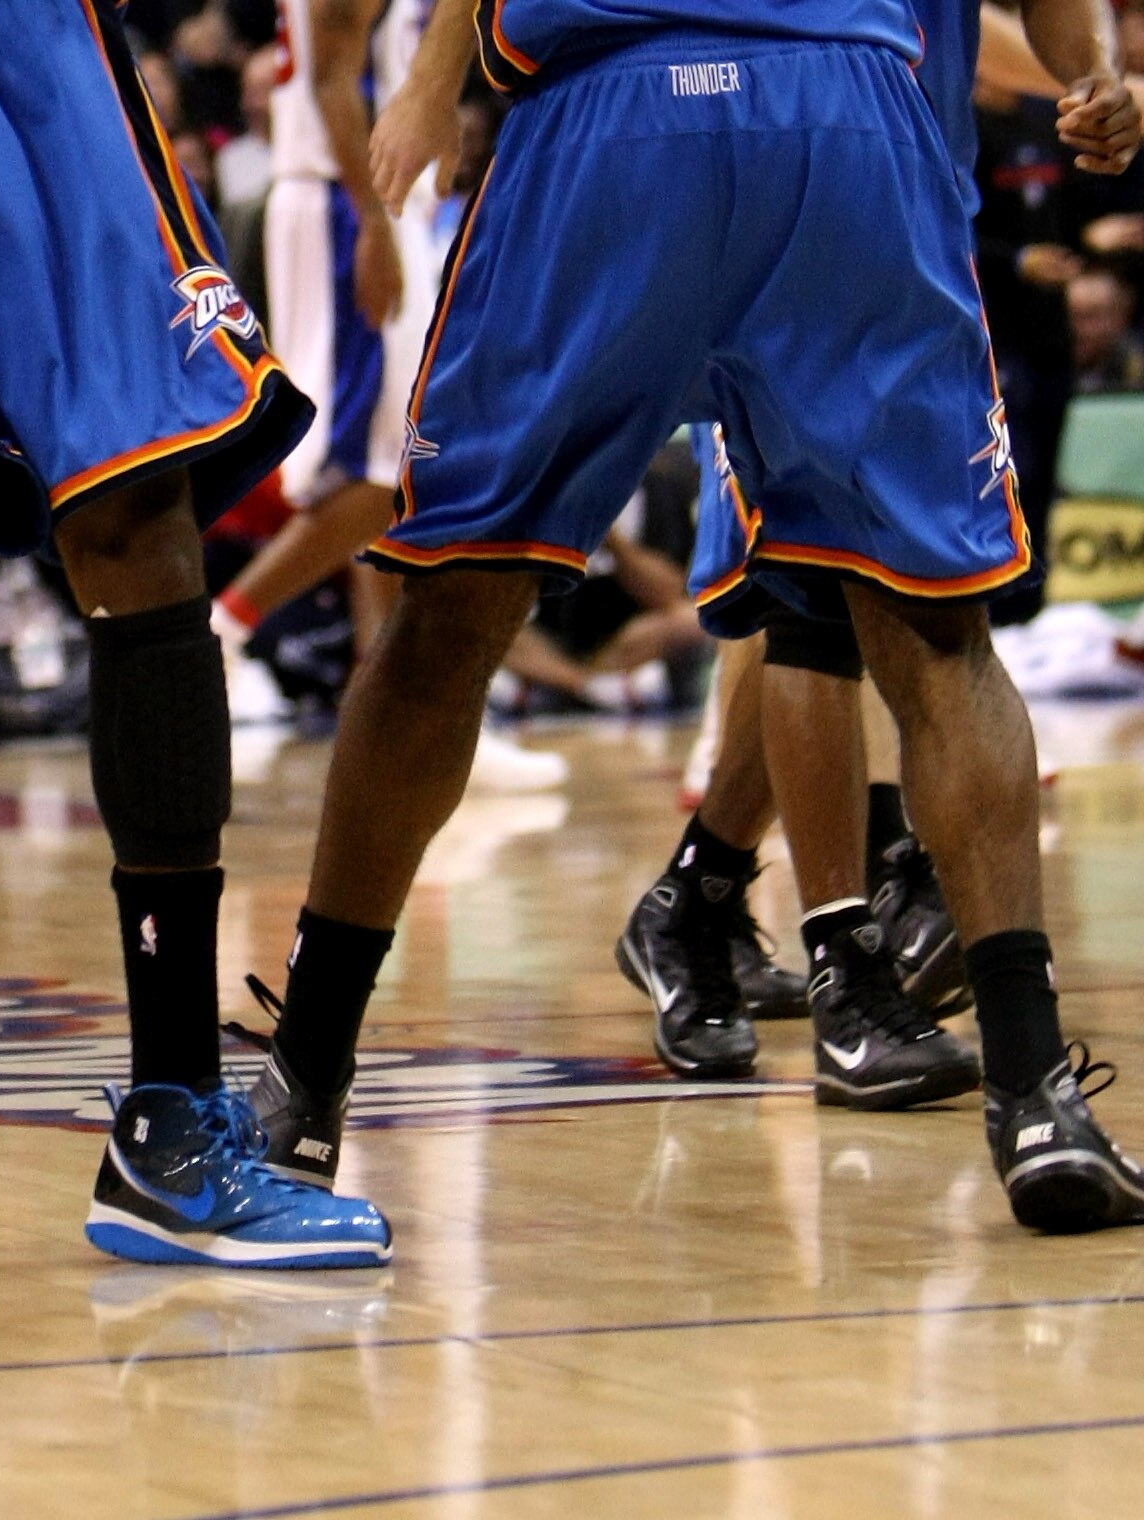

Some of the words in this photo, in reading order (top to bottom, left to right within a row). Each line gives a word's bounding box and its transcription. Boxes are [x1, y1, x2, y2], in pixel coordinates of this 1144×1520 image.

[668, 62, 742, 97] THUNDER
[294, 1137, 333, 1162] NIKE
[1015, 1122, 1056, 1153] NIKE
